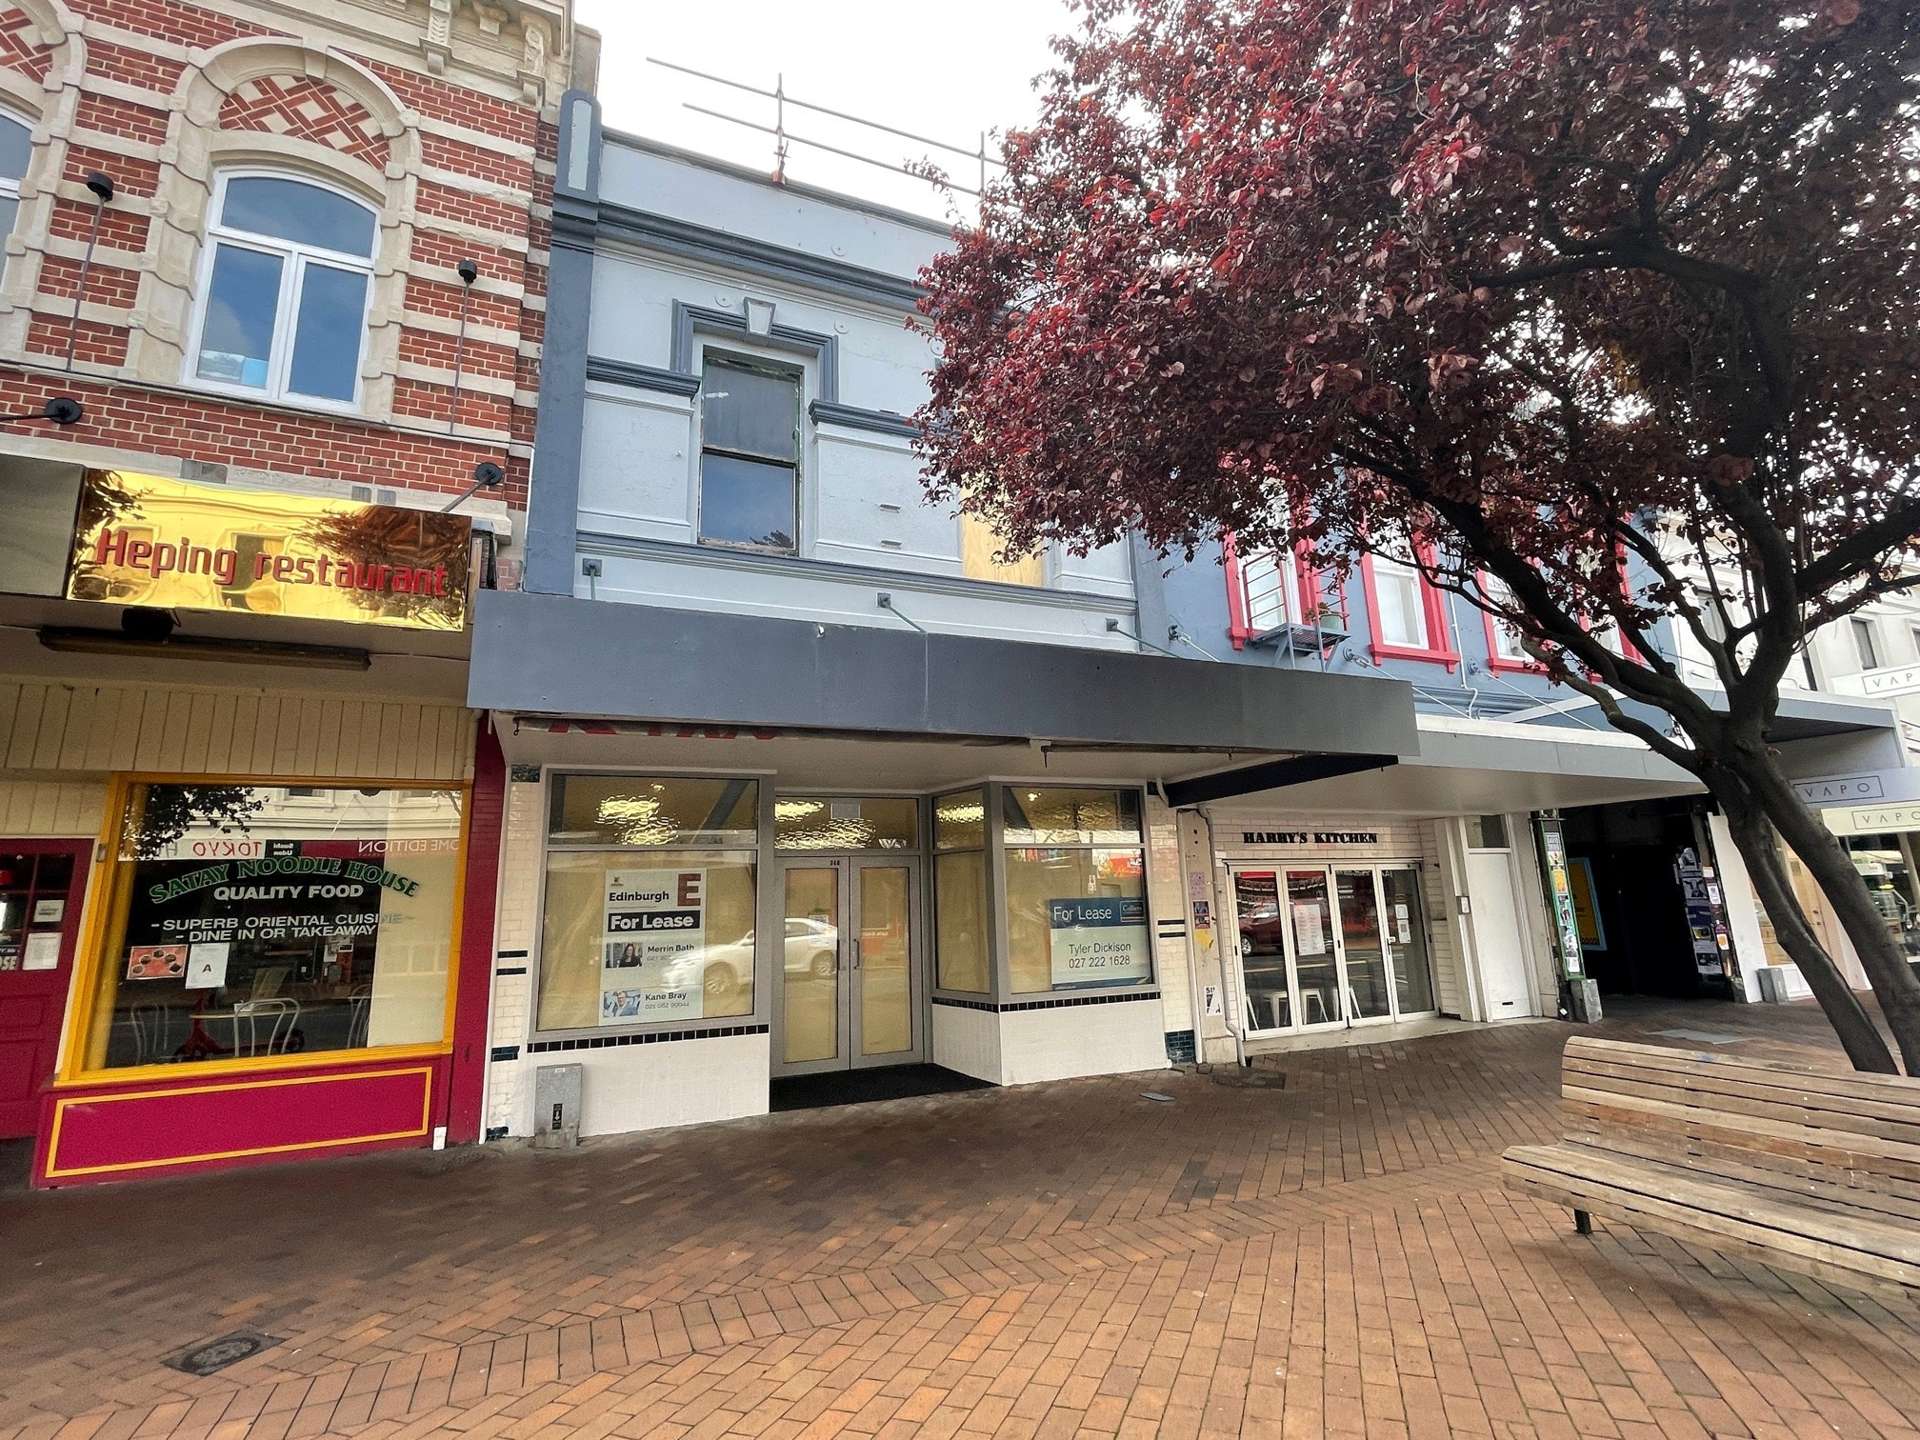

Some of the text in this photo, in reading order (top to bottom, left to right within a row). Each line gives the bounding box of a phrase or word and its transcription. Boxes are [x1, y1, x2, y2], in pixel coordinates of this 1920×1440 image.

[95, 528, 450, 598] Heping restaurant
[1805, 782, 1870, 798] VAPO
[1242, 831, 1378, 844] HARRY'S KITCHEN
[149, 855, 420, 904] SATAY NOODLE HOUSE
[213, 884, 364, 901] QUALITY FOOD
[609, 891, 670, 903] Edinburgh
[1053, 906, 1112, 921] For Lease
[162, 917, 239, 931] SUPERB
[245, 915, 330, 929] ORIENTAL
[611, 914, 695, 930] For Lease
[189, 930, 232, 943] DINE
[238, 928, 255, 940] IN
[260, 928, 286, 940] OR
[291, 925, 377, 939] TAKEAWAY
[675, 944, 695, 952] Bath
[1068, 942, 1131, 956] Tyler Dickison
[202, 963, 212, 973] A
[1068, 955, 1131, 969] 027 222 1628
[645, 991, 687, 1001] Kane Bray
